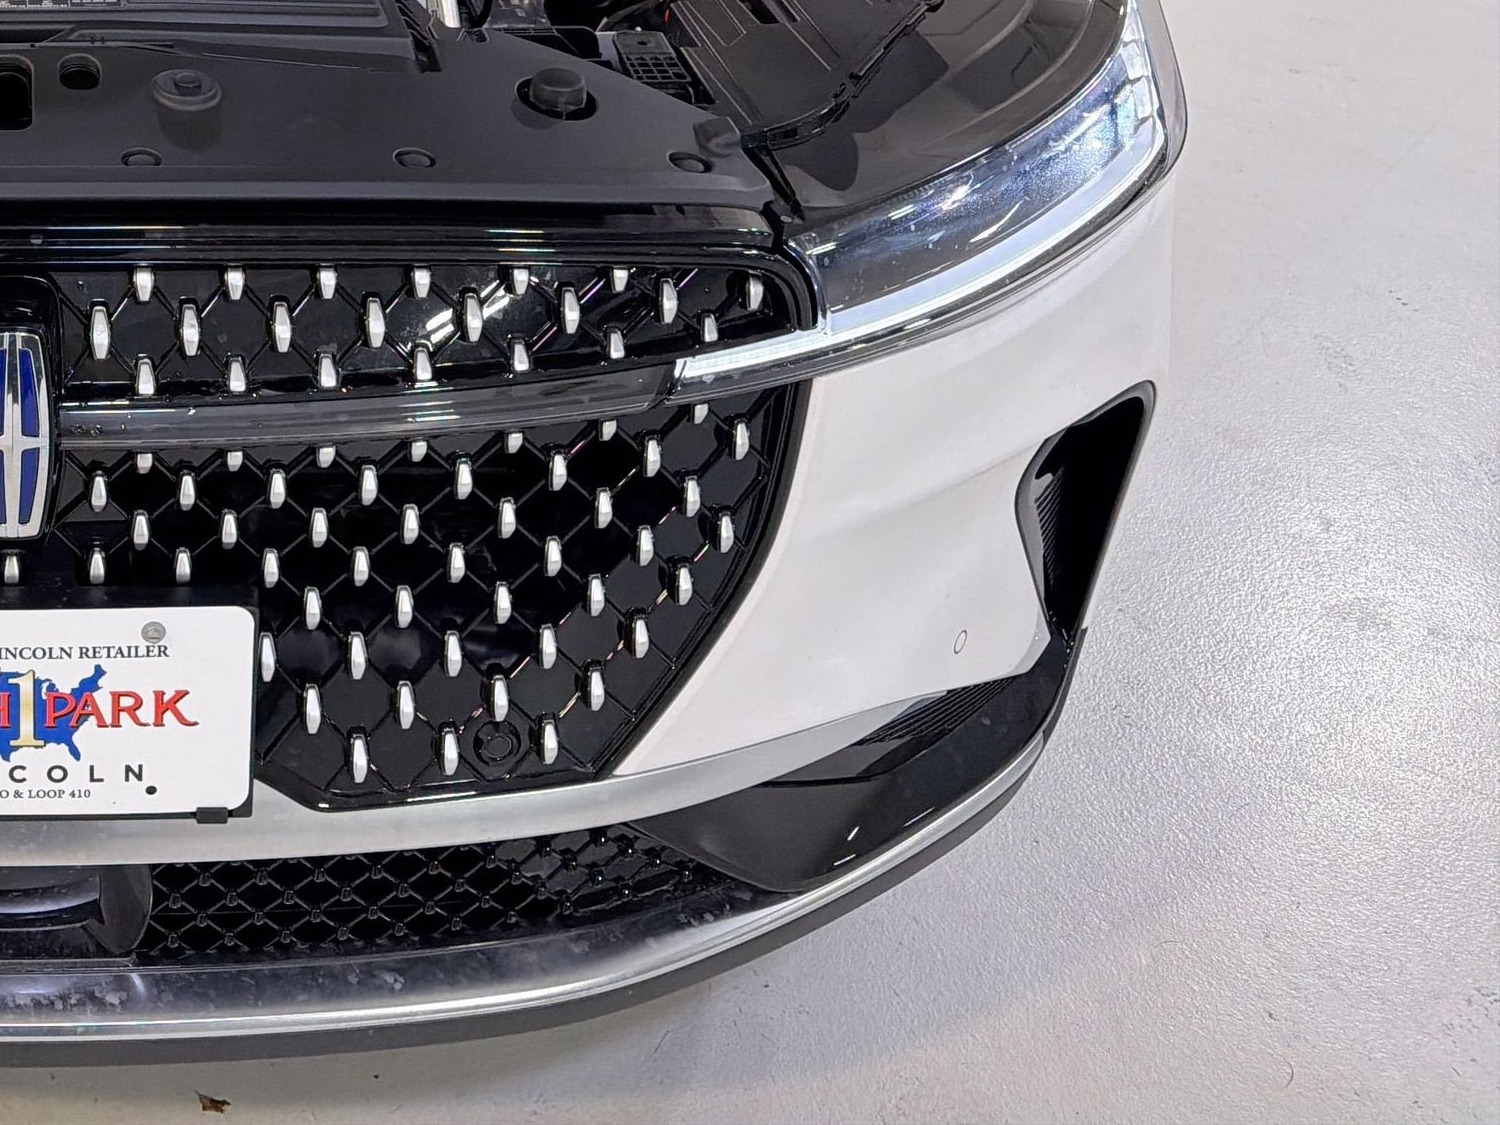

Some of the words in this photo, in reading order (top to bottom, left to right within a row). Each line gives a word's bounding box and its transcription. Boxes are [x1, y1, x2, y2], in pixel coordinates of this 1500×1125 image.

[77, 644, 170, 659] RETAILER
[45, 690, 199, 728] PARK
[13, 789, 23, 799] &
[27, 788, 66, 799] LOOP
[69, 788, 91, 799] 410
